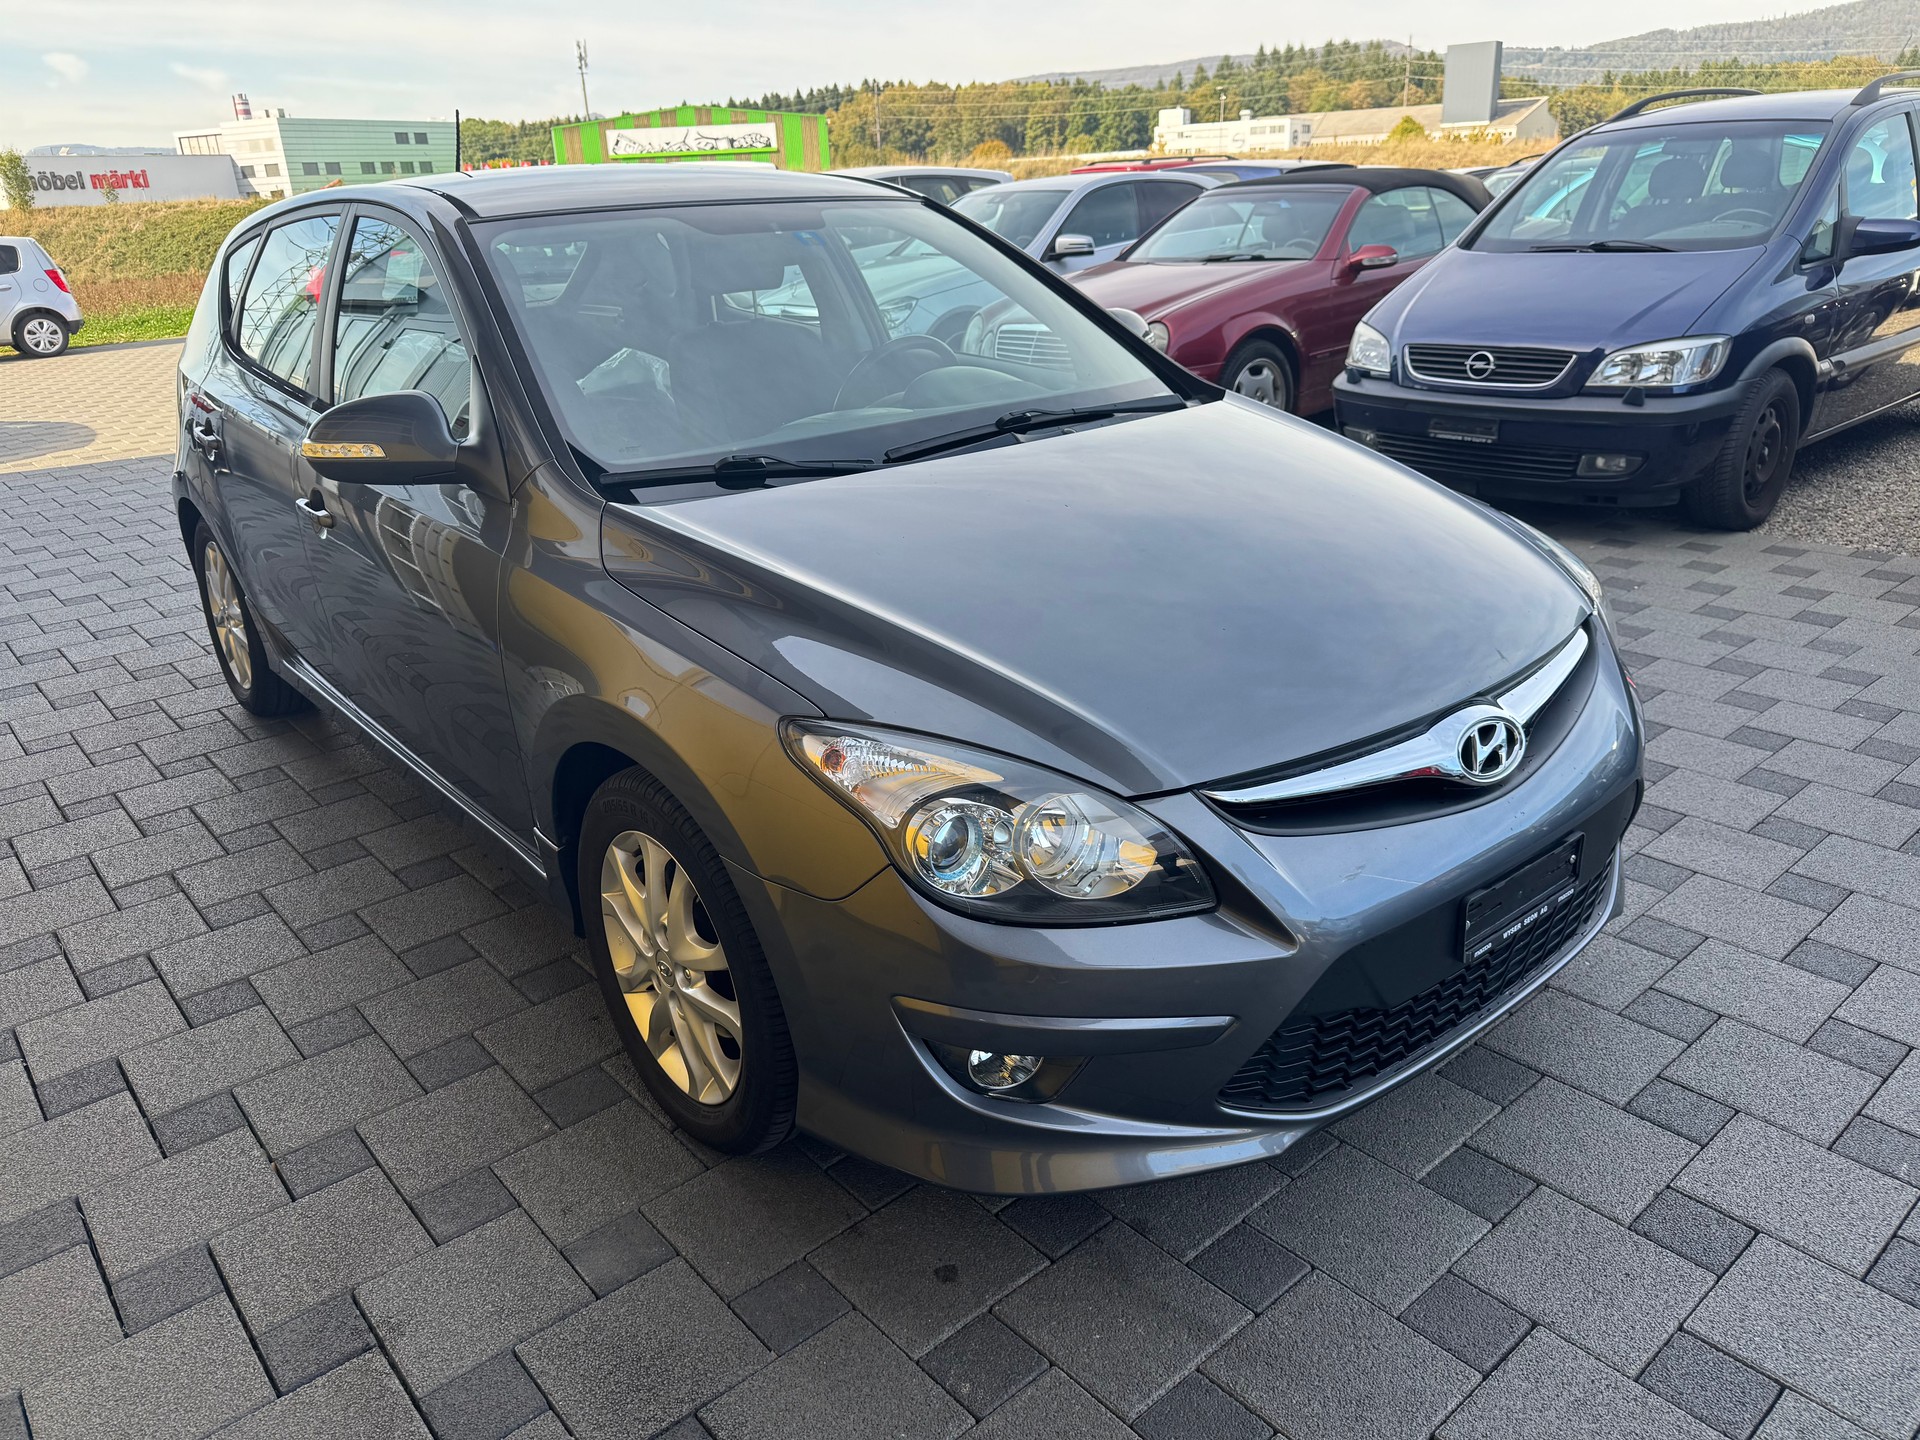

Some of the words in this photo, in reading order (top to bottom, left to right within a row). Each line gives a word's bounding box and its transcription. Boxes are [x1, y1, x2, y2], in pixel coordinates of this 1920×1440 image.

[90, 170, 150, 190] märki
[1503, 922, 1522, 939] WYSER
[1523, 912, 1538, 926] SEON
[1540, 905, 1548, 915] AG
